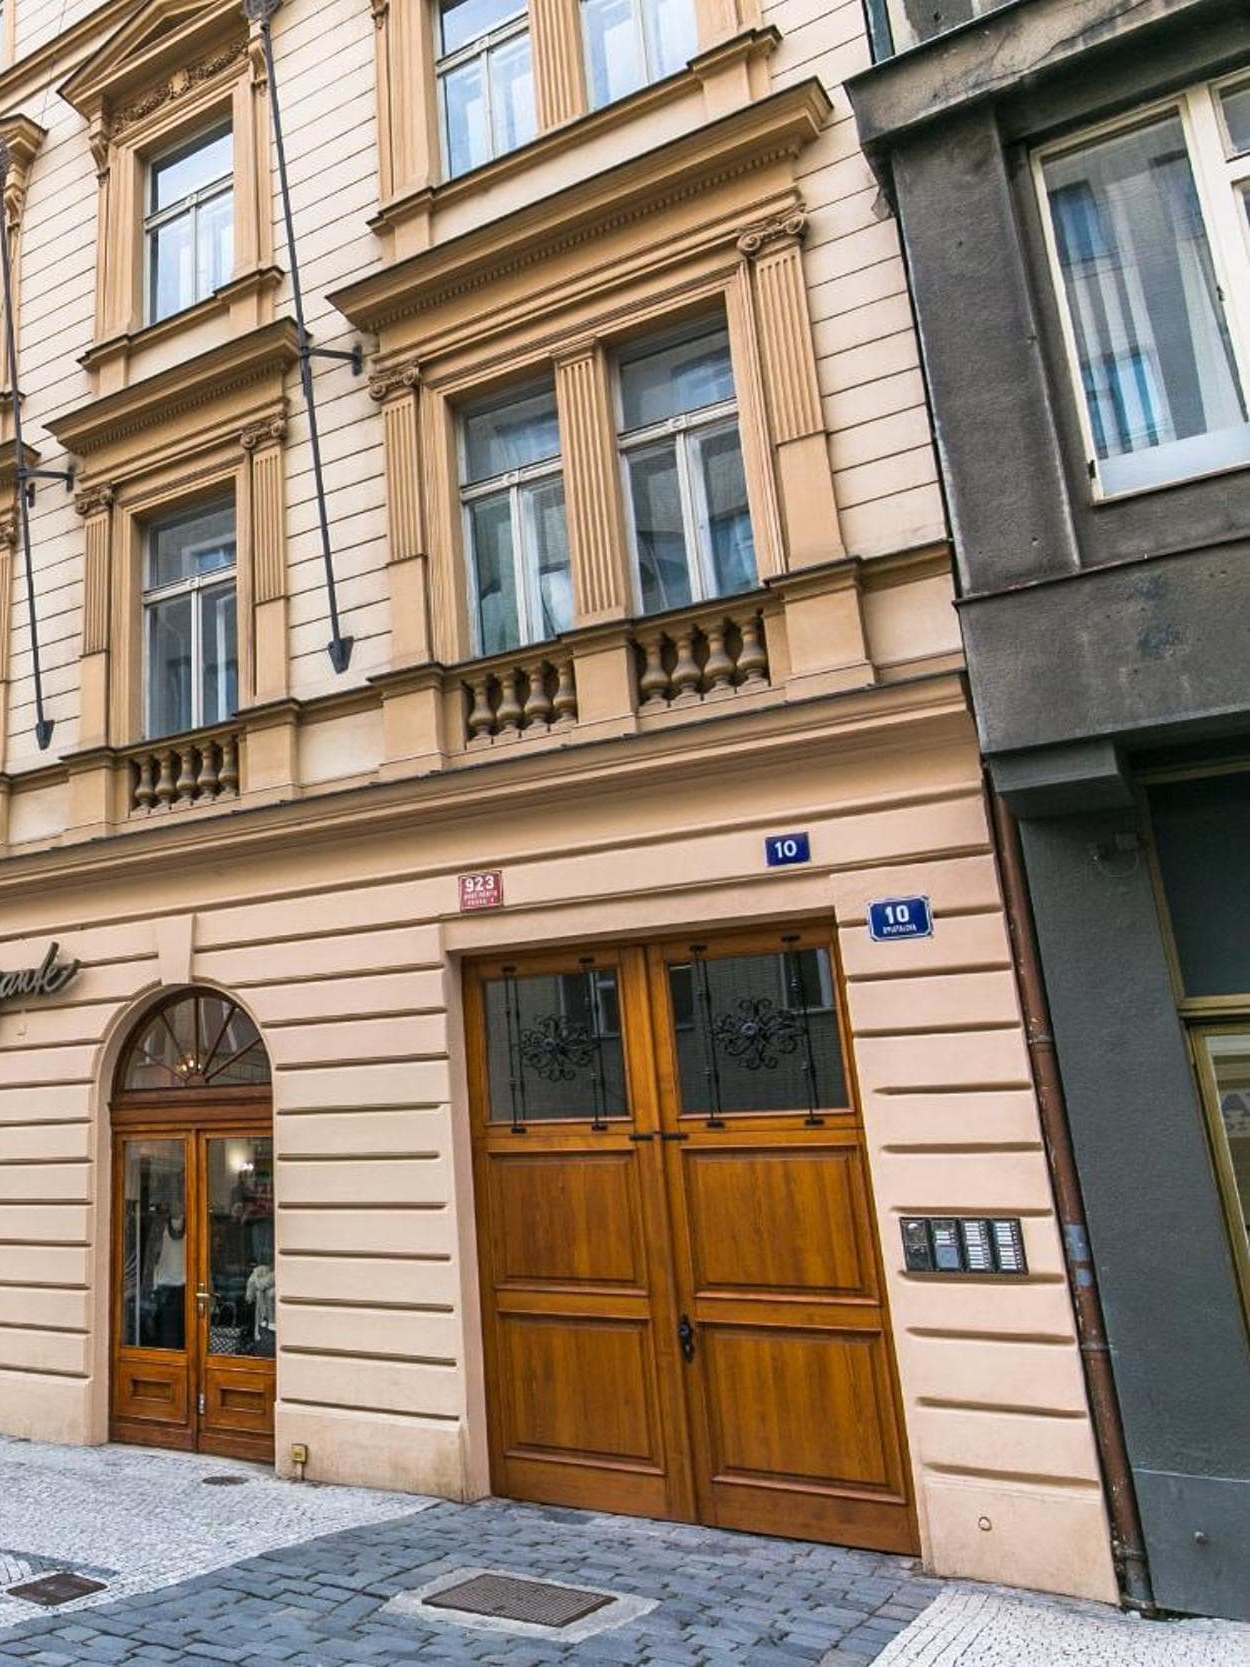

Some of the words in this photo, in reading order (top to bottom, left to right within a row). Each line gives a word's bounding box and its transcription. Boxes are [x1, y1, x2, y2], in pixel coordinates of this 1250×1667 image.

[774, 839, 798, 859] 10
[465, 875, 495, 892] 923
[884, 904, 910, 924] 10
